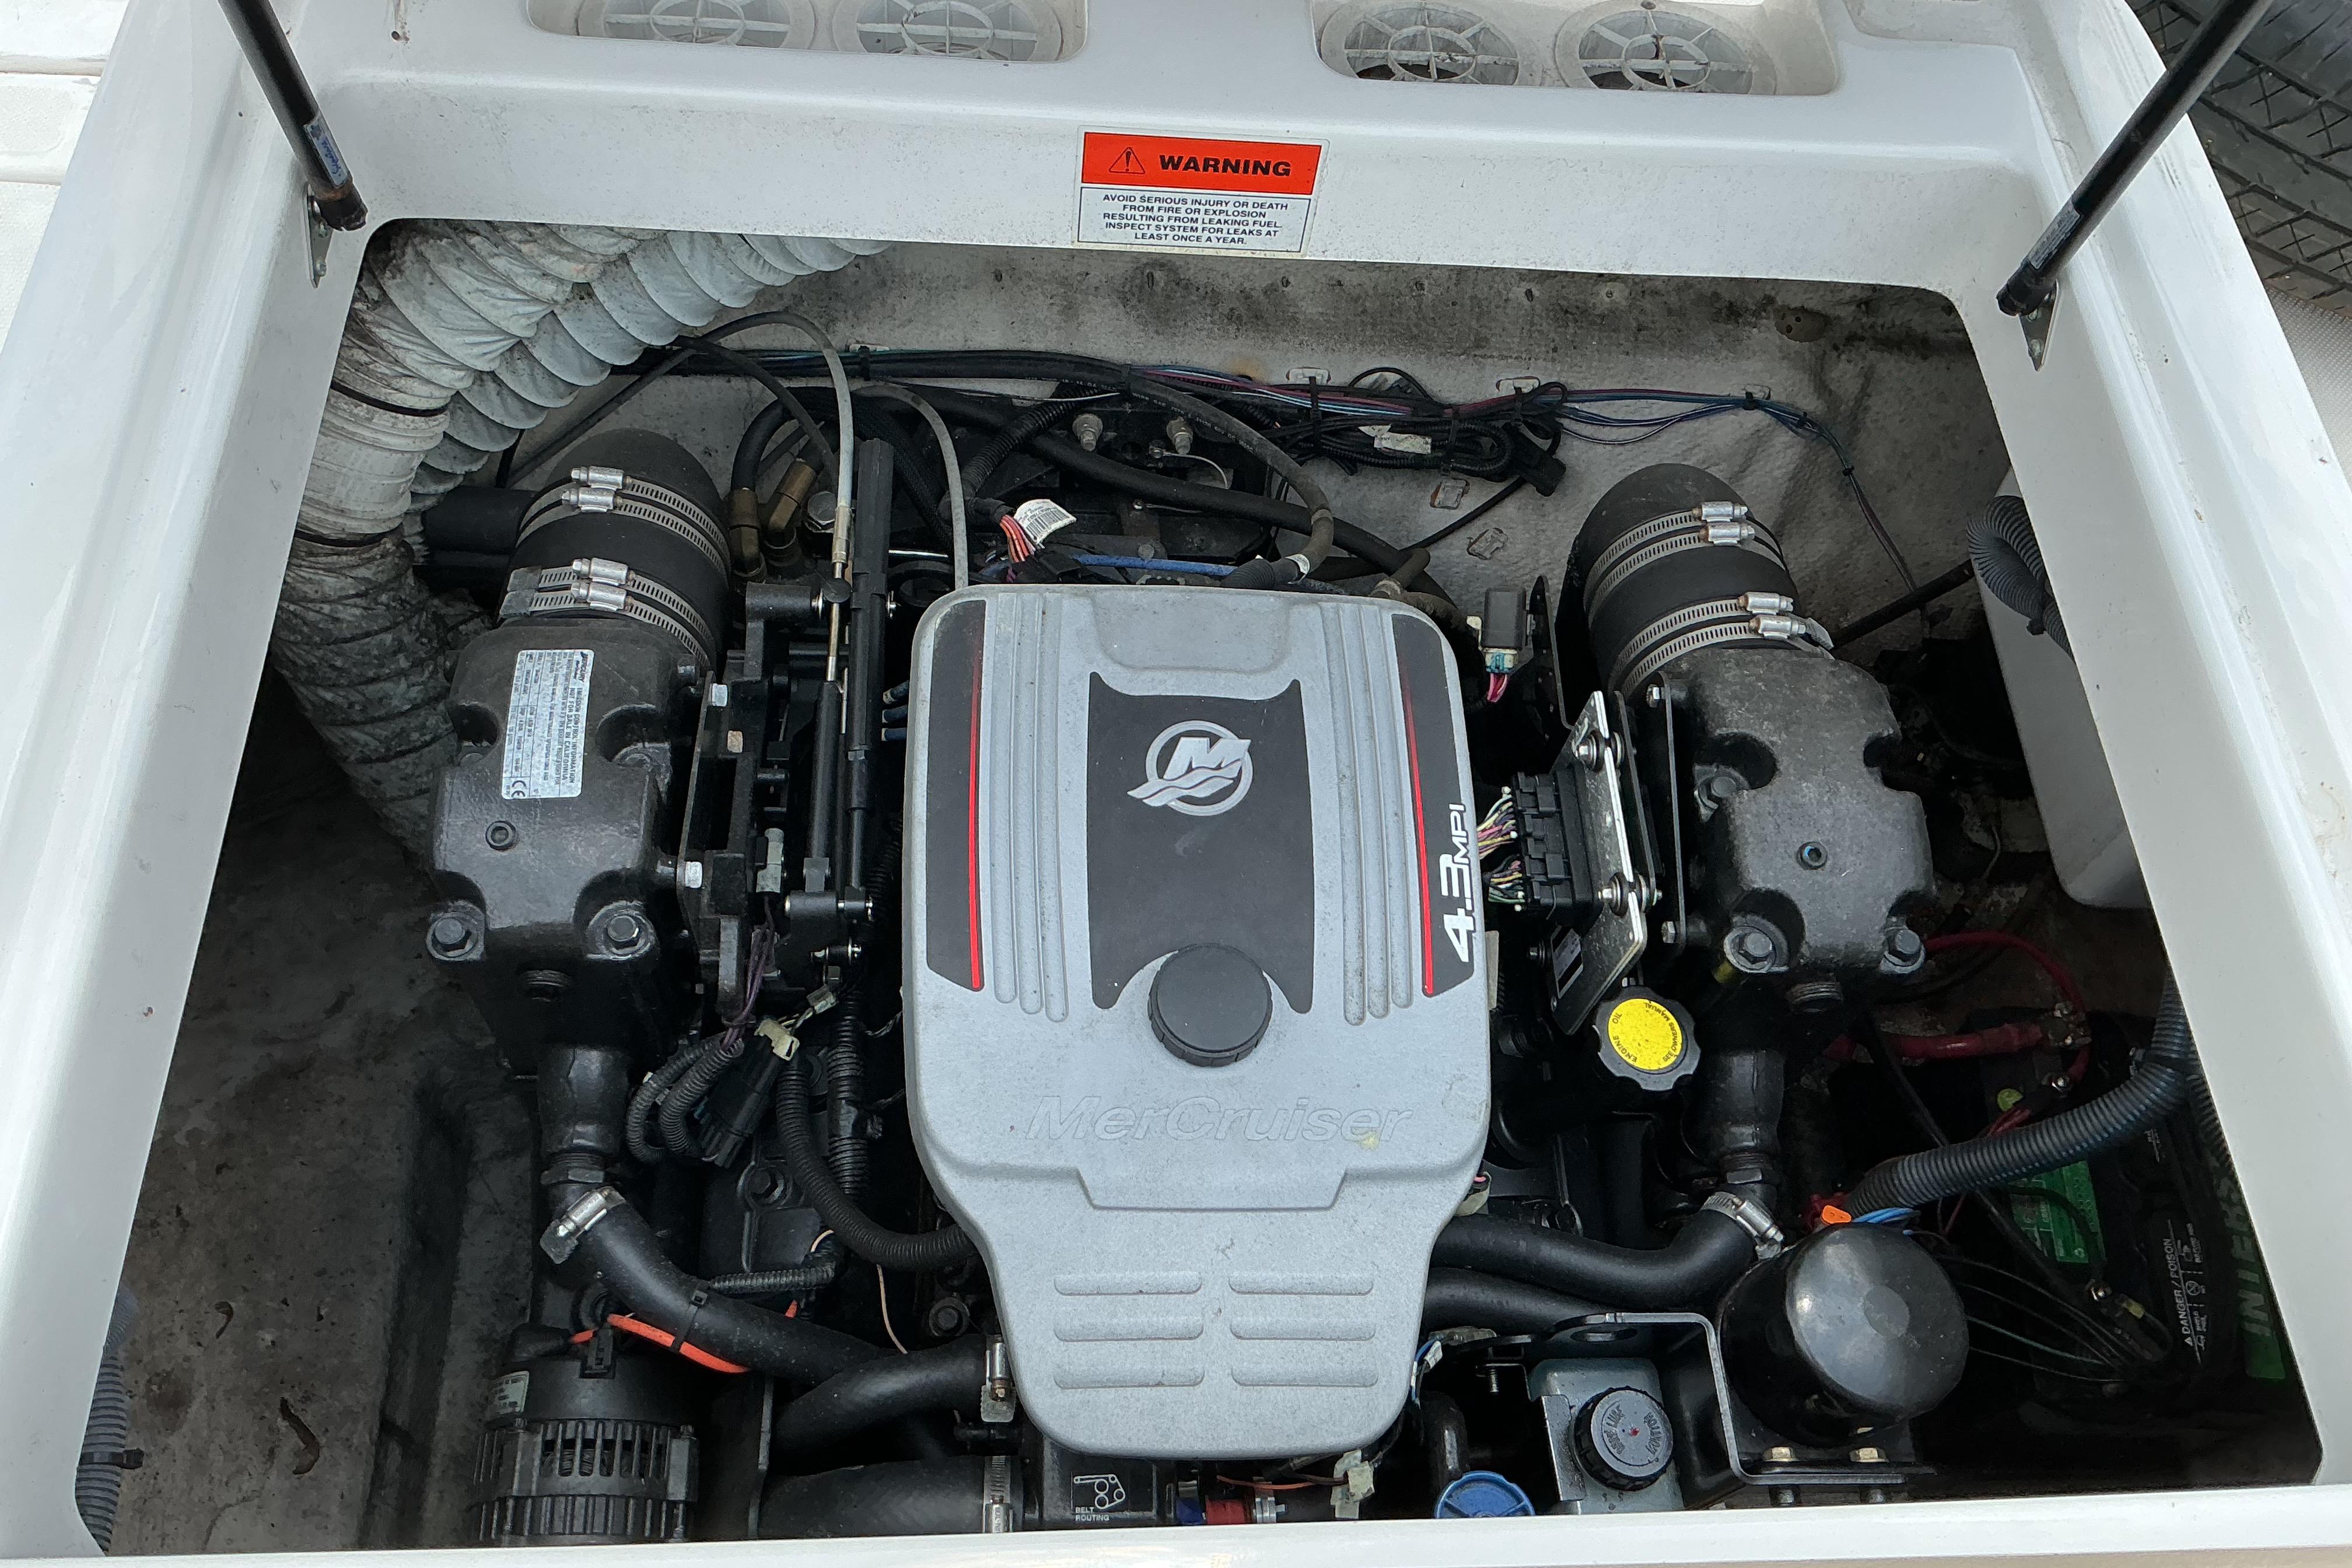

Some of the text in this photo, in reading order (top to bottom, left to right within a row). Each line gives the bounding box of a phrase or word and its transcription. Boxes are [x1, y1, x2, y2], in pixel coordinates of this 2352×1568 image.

[1159, 155, 1291, 176] WARNING
[1102, 194, 1136, 202] AVOID
[1139, 195, 1188, 205] SERIOUS
[1191, 198, 1230, 207] INJURY
[1252, 202, 1288, 210] DEATH
[1123, 204, 1154, 213] FROM
[1204, 208, 1266, 219] EXPLOSION
[1103, 212, 1164, 222] RESULTING
[1202, 218, 1249, 226] LEAKING
[1252, 220, 1283, 228] FUEL.
[1105, 222, 1152, 230] INSPECT
[1155, 224, 1198, 233] SYSTEM
[1227, 228, 1262, 236] LEAKS
[1216, 236, 1247, 244] YEAR.
[562, 740, 570, 780] CALIFORNIA
[1440, 804, 1475, 963] 4.3 MPI
[1643, 1002, 1670, 1022] MANUAL
[1612, 1013, 1637, 1063] ENGINE OIL
[1669, 1022, 1678, 1052] OWNERS
[1025, 1096, 1413, 1141] MerCruiser
[2162, 1238, 2179, 1279] POISON
[2174, 1289, 2191, 1335] DANGER
